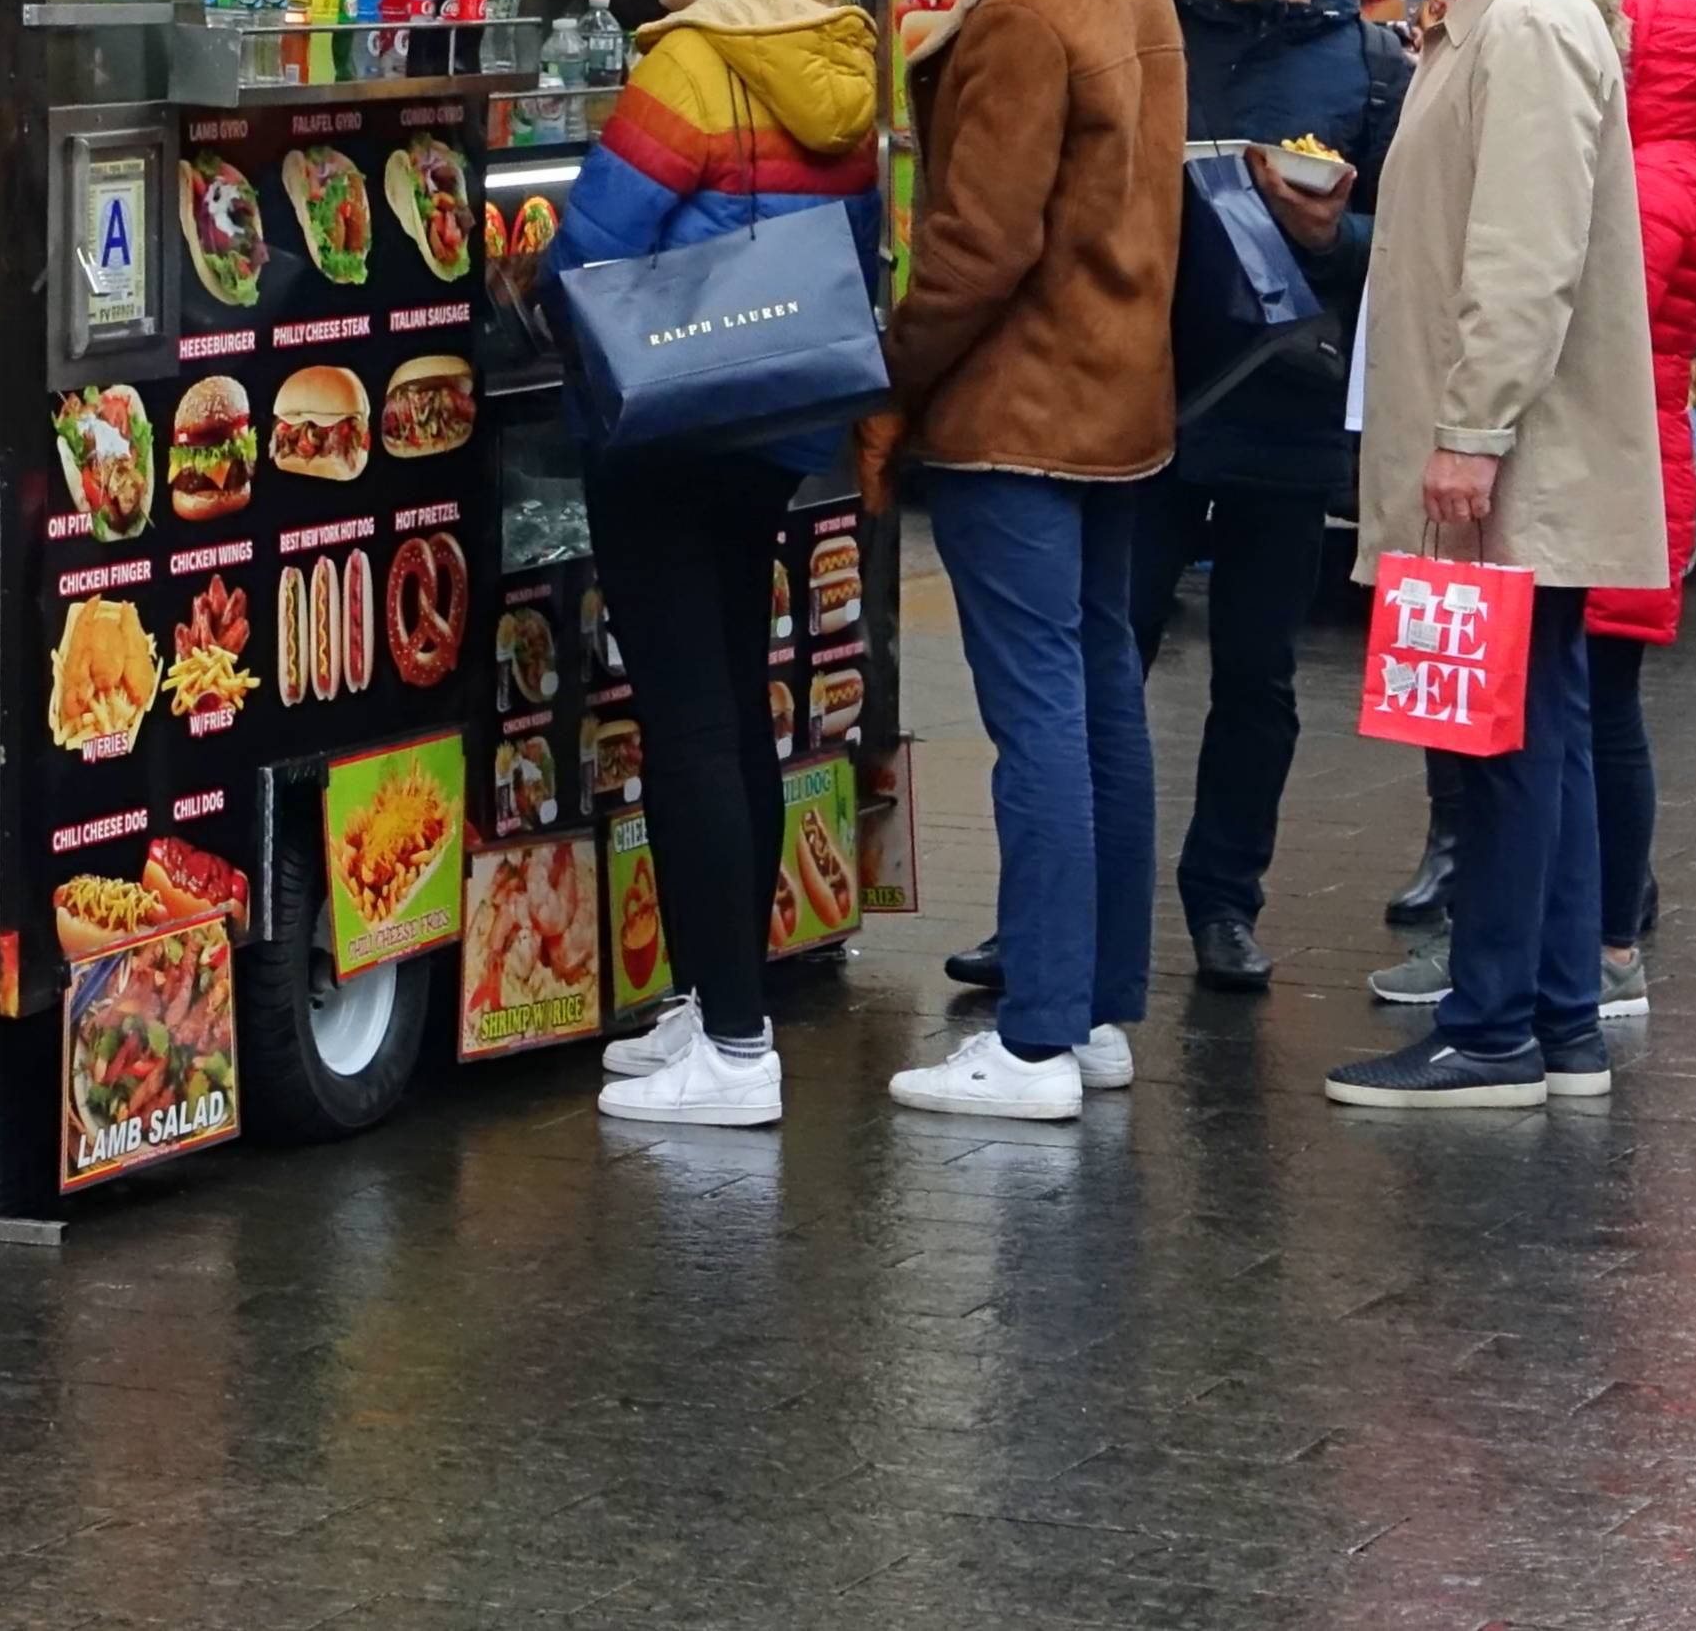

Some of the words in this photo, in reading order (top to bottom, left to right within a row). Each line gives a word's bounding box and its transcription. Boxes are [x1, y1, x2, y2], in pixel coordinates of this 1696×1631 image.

[189, 122, 215, 141] LAMB
[217, 120, 249, 140] GYRO
[292, 114, 333, 135] FALAFEL
[335, 111, 363, 132] GYRO
[101, 199, 131, 268] A
[272, 324, 305, 349] PHILLY
[305, 320, 341, 344] CHEESE
[341, 315, 371, 338] STEAK
[389, 307, 426, 332] ITALIAN
[427, 303, 471, 327] SAUSAGE
[649, 320, 713, 347] RALPH
[723, 300, 801, 329] LAUREN
[179, 331, 256, 360] HEESEBURGER
[395, 509, 415, 531] HOT
[417, 502, 461, 527] PRETZEL
[279, 531, 300, 553] BEST
[300, 527, 319, 550] NEW
[318, 524, 342, 546] YORK
[340, 522, 358, 543] HOT
[357, 519, 375, 539] DOG
[170, 549, 217, 574] CHICKEN
[217, 541, 253, 565] WINGS
[59, 566, 111, 596] CHICKEN
[111, 560, 152, 584] FINGER
[1384, 589, 1488, 661] THE
[1374, 653, 1488, 726] MET
[190, 709, 234, 737] W/FRIES
[82, 731, 129, 762] W/FRIES
[174, 796, 201, 822] CHILI
[202, 790, 225, 814] DOG
[53, 827, 82, 852] CHILI
[83, 814, 124, 845] CHEESE
[123, 809, 148, 833] DOG
[482, 1002, 531, 1040] SHRIMP
[553, 994, 584, 1027] RICE
[77, 1116, 143, 1170] LAMB
[149, 1089, 226, 1145] SALAD
